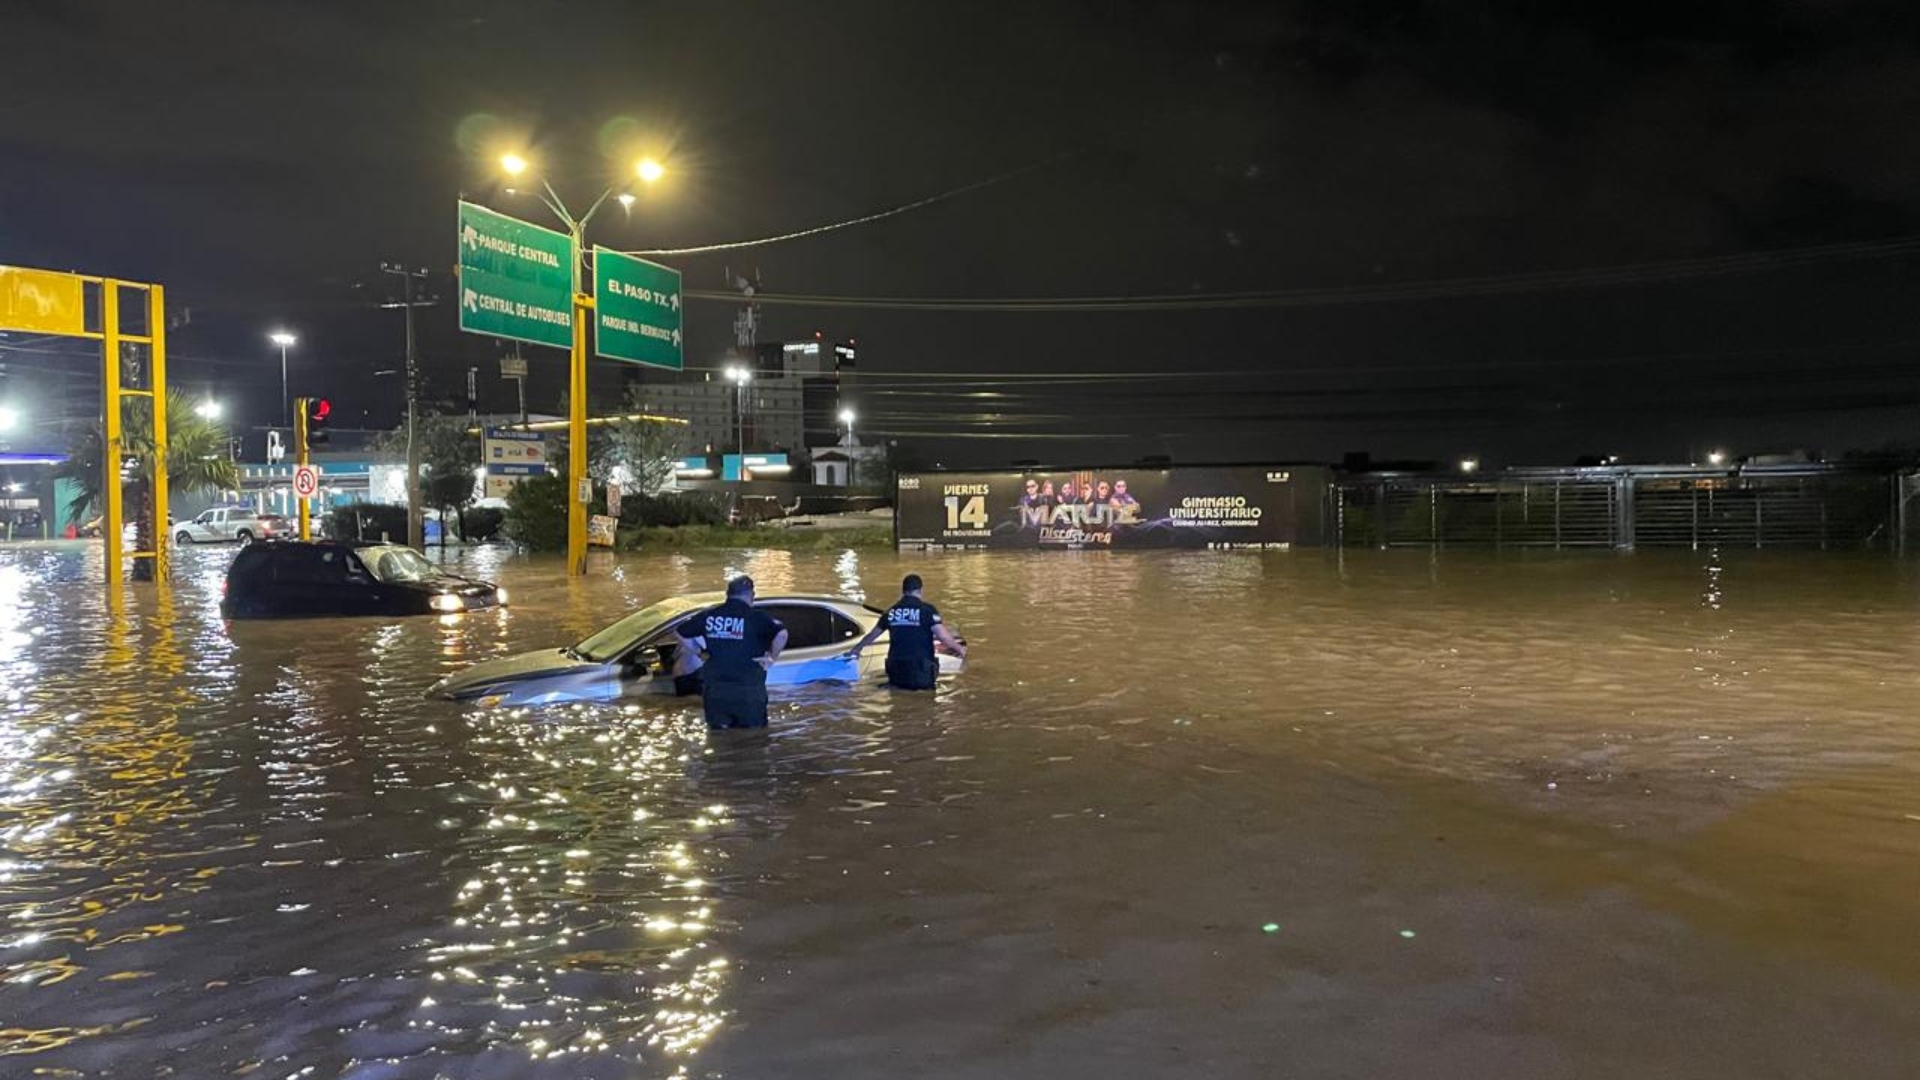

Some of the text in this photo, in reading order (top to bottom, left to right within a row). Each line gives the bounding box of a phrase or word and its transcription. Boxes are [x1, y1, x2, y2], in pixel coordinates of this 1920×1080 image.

[479, 234, 559, 268] PARQUE CENTRAL
[608, 278, 622, 294] EL
[624, 283, 651, 302] PASO
[479, 294, 570, 327] CENTRAL DE AUTOBUSES
[602, 314, 627, 331] PARQUE
[944, 484, 989, 495] VIERNES
[1181, 496, 1246, 508] GIMNASIO
[944, 496, 989, 529] 14
[1169, 507, 1262, 518] UNIVERSITARIO
[887, 608, 921, 621] SSPM
[705, 616, 745, 633] SSPM
